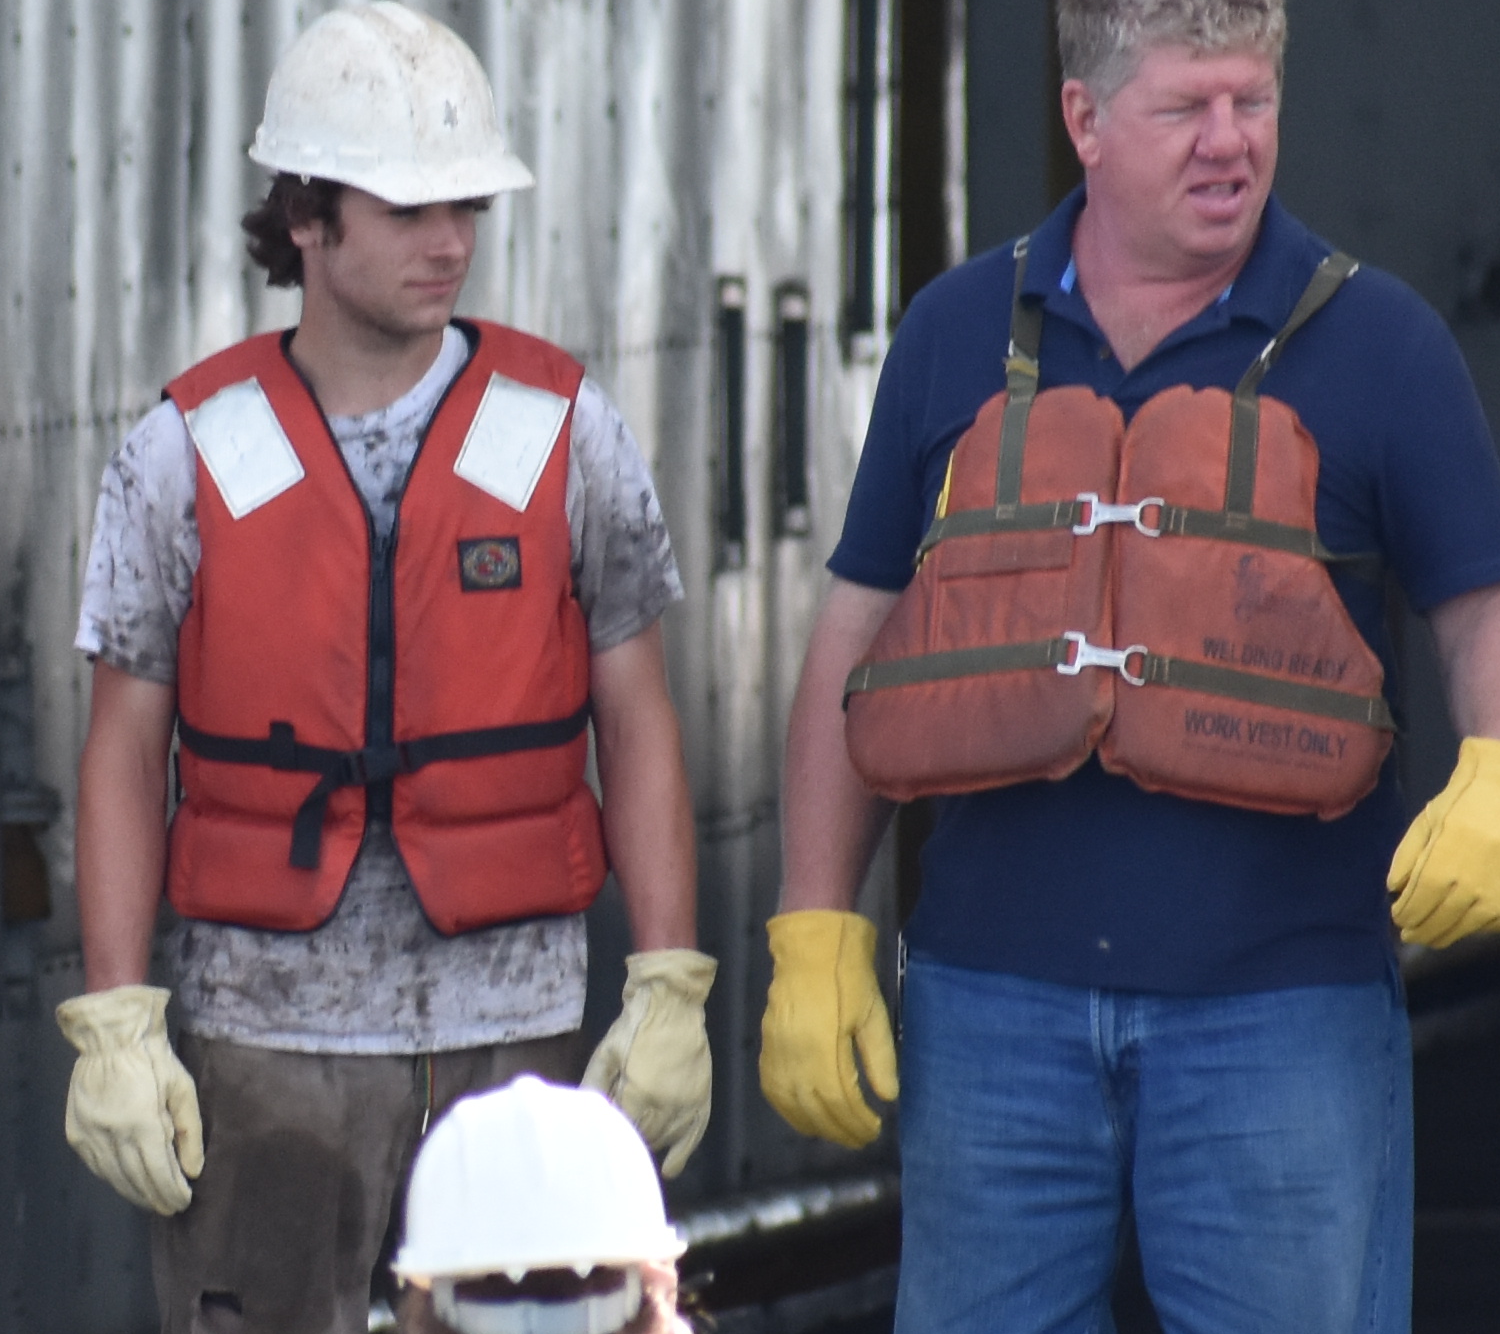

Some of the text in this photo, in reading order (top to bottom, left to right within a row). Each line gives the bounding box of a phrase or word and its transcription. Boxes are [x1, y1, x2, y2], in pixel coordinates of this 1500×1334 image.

[1288, 652, 1349, 683] READY
[1184, 709, 1242, 741] WORK
[1247, 720, 1293, 748] VEST
[1298, 727, 1348, 759] ONLY
